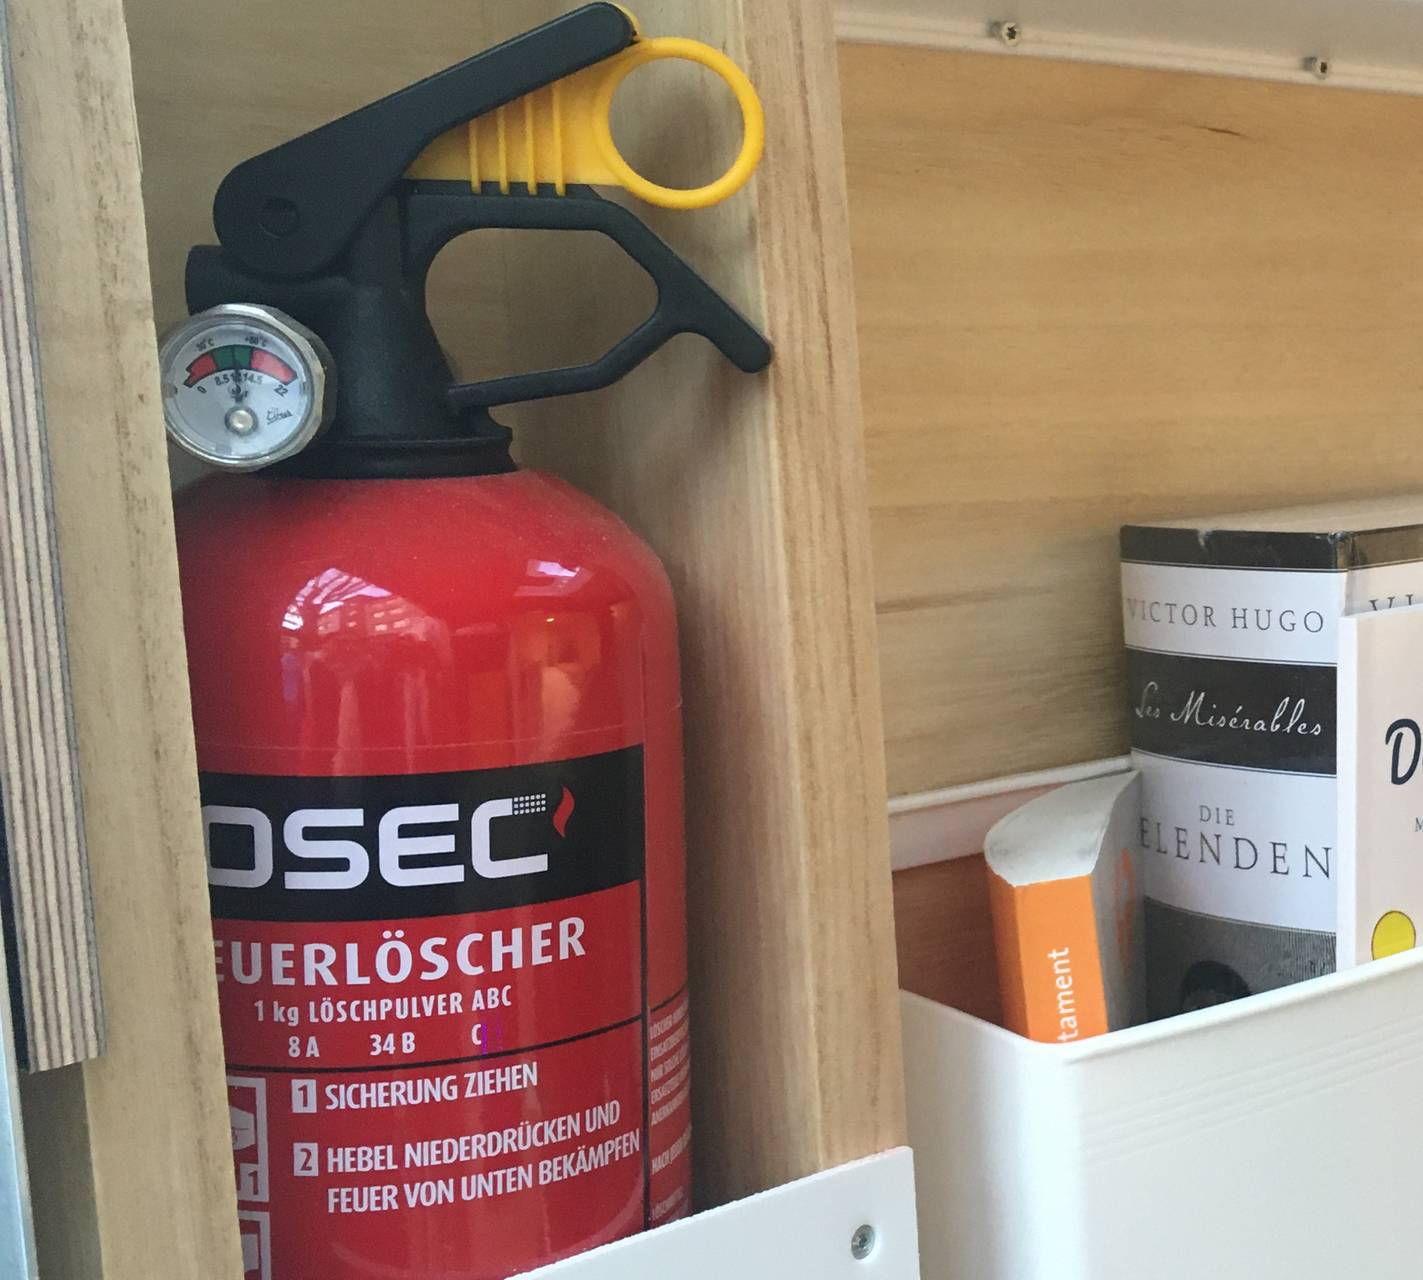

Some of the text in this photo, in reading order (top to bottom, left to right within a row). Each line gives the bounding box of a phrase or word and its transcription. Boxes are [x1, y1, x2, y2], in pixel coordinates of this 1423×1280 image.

[273, 384, 289, 397] 22
[1126, 598, 1325, 633] VICTOR HUGO
[1135, 681, 1323, 736] Les Misérables
[1199, 804, 1236, 827] DIE
[1140, 817, 1333, 879] ELENDEN
[254, 985, 512, 1027] 1 kg LÖSCHPULVER ABC
[324, 1075, 458, 1110] SICHERUNG
[464, 1061, 538, 1099] ZIEHEN
[327, 1144, 398, 1174] HEBEL
[404, 1121, 580, 1169] NIEDERDRÜCKEN
[584, 1099, 620, 1134] UND
[327, 1184, 399, 1213] FEUER
[403, 1179, 455, 1209] VON
[461, 1164, 532, 1200] UNTEN
[538, 1127, 641, 1186] BEKÄMPFEN
